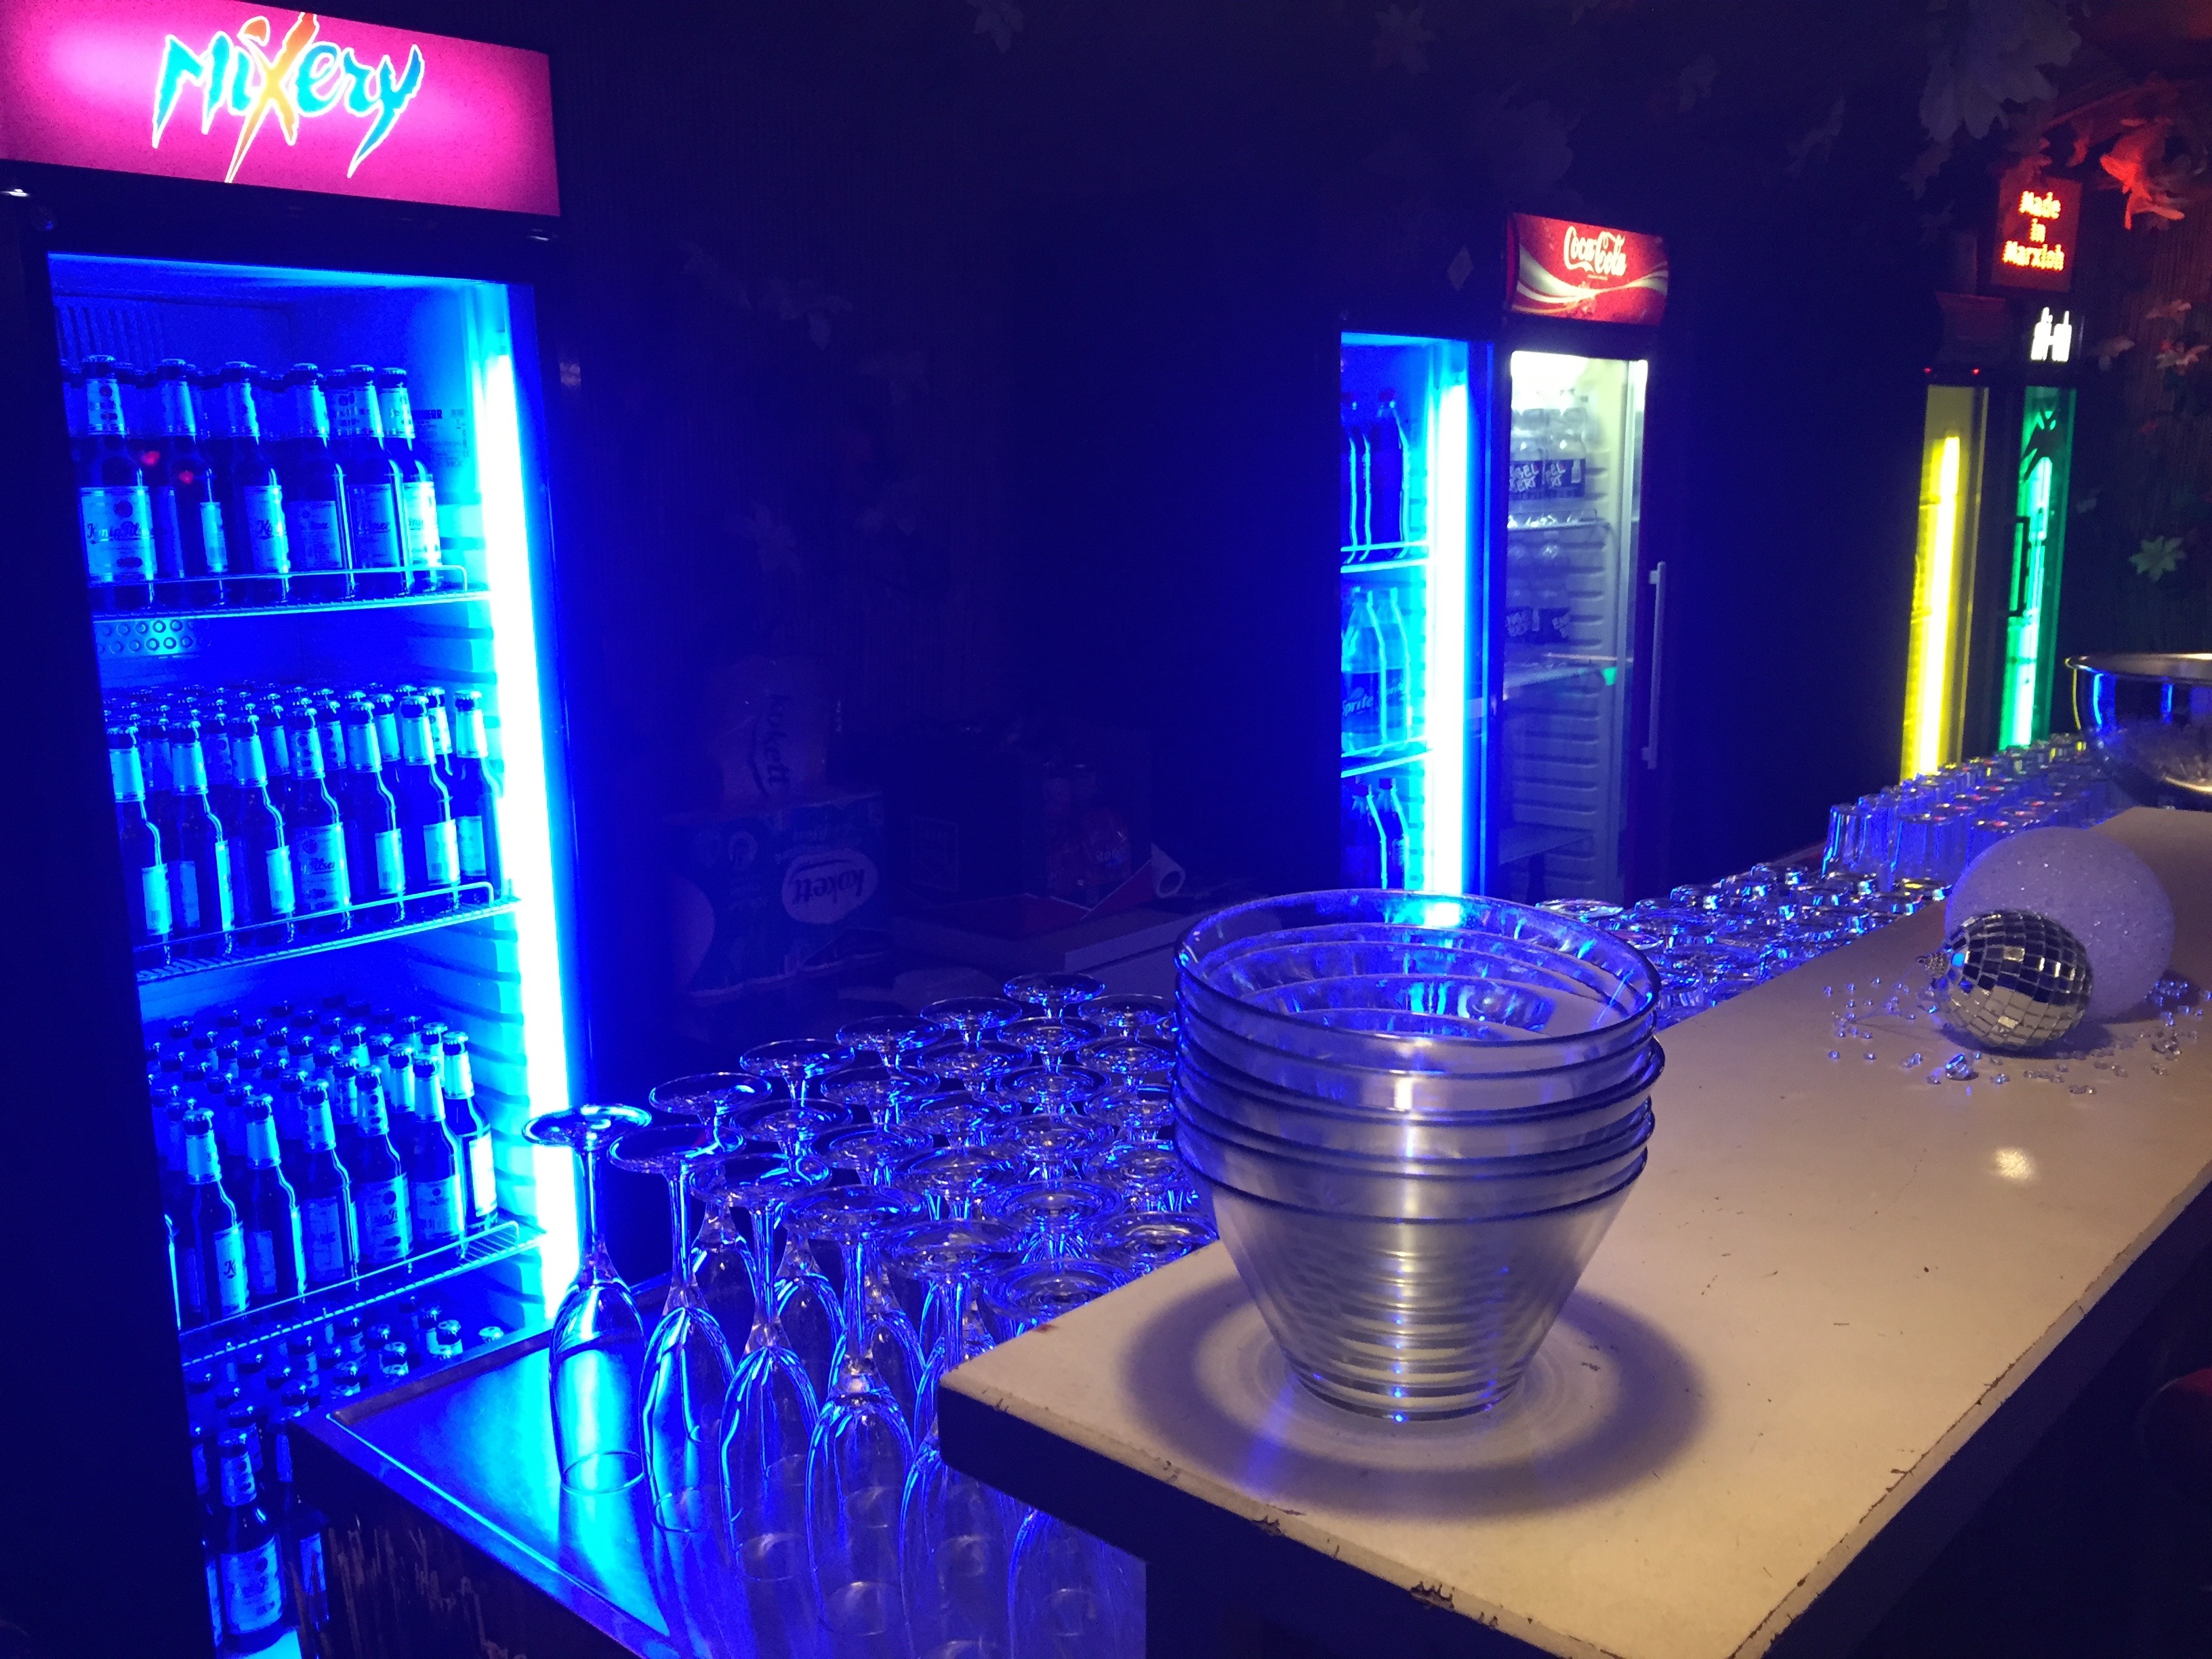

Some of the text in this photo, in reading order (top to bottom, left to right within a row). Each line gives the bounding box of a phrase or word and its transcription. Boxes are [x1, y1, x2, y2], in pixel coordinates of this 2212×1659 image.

[2019, 190, 2062, 220] Made
[2030, 218, 2046, 243] in
[792, 868, 865, 905] kokett
